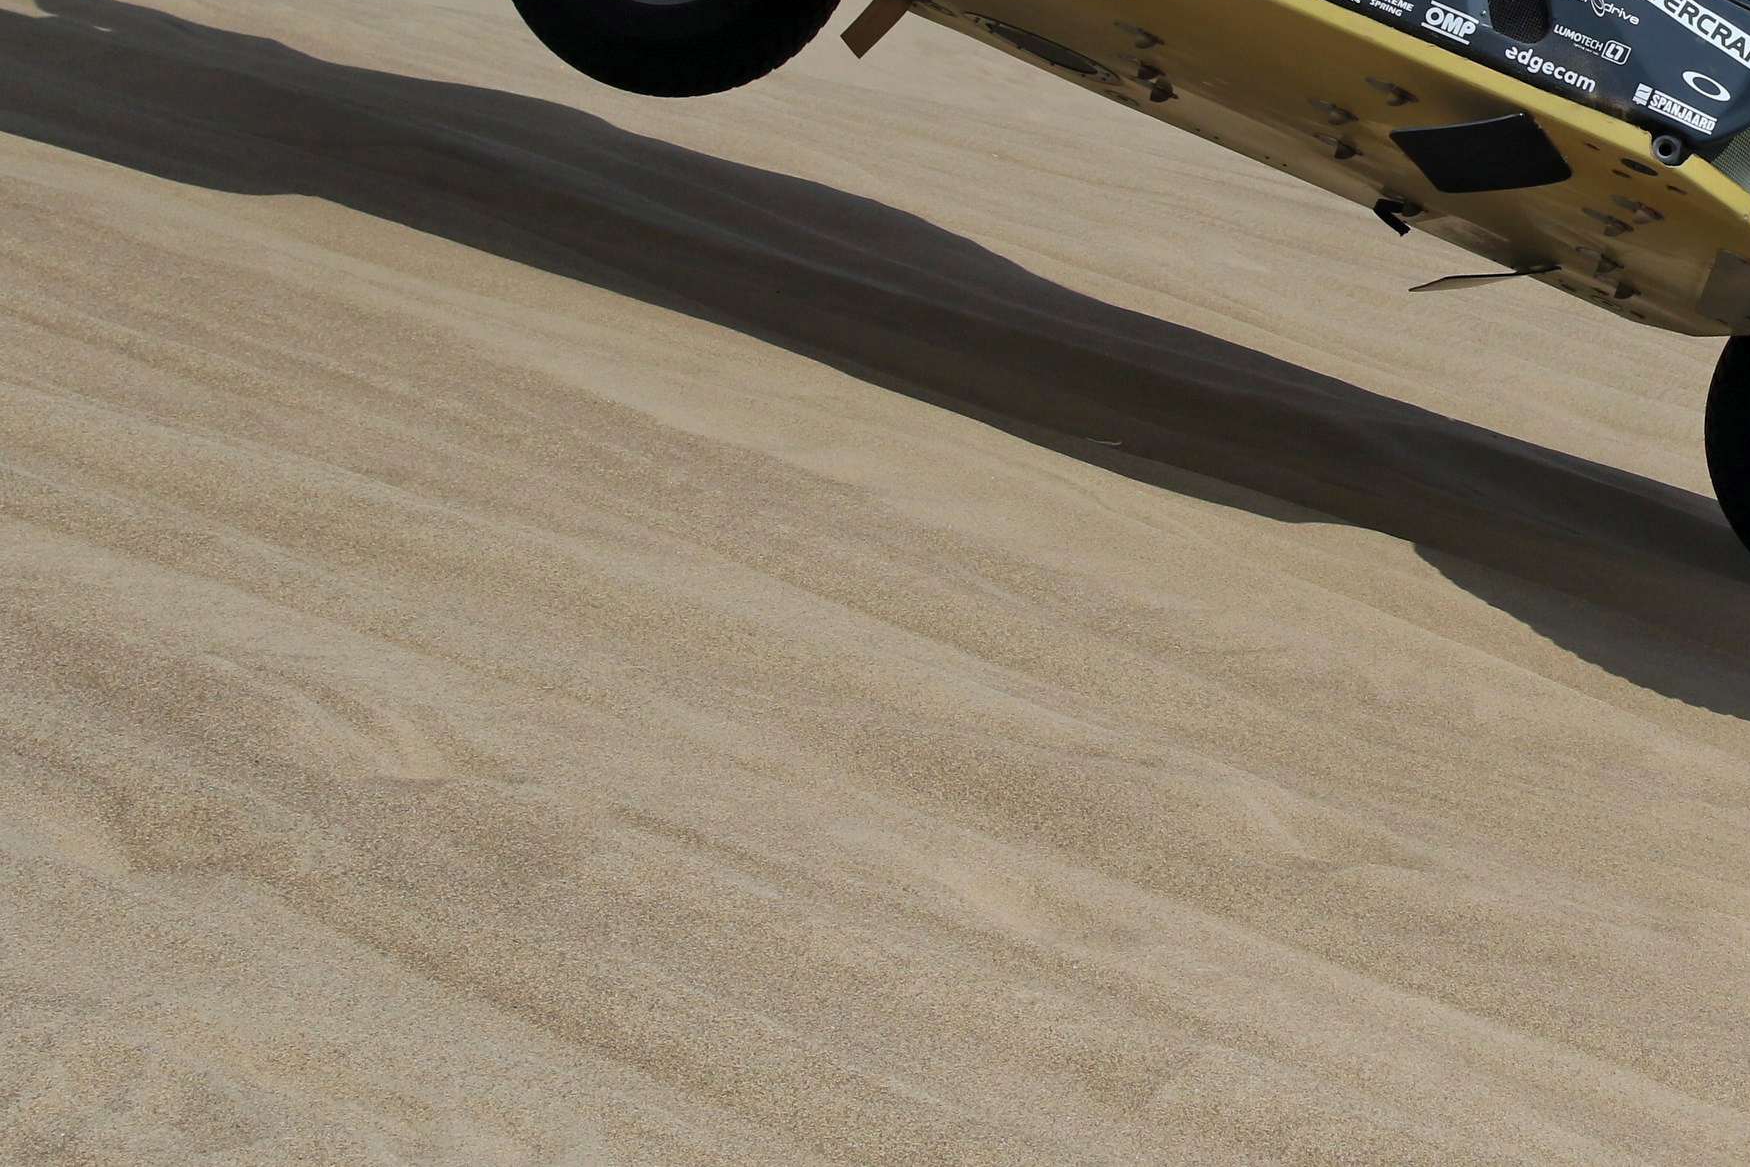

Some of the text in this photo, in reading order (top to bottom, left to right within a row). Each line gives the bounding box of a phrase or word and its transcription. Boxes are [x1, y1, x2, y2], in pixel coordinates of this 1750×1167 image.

[1425, 7, 1476, 38] OMP
[1553, 24, 1604, 51] LUMOTECH
[1504, 46, 1597, 94] edgecam
[1649, 94, 1716, 132] SPANJAARD
